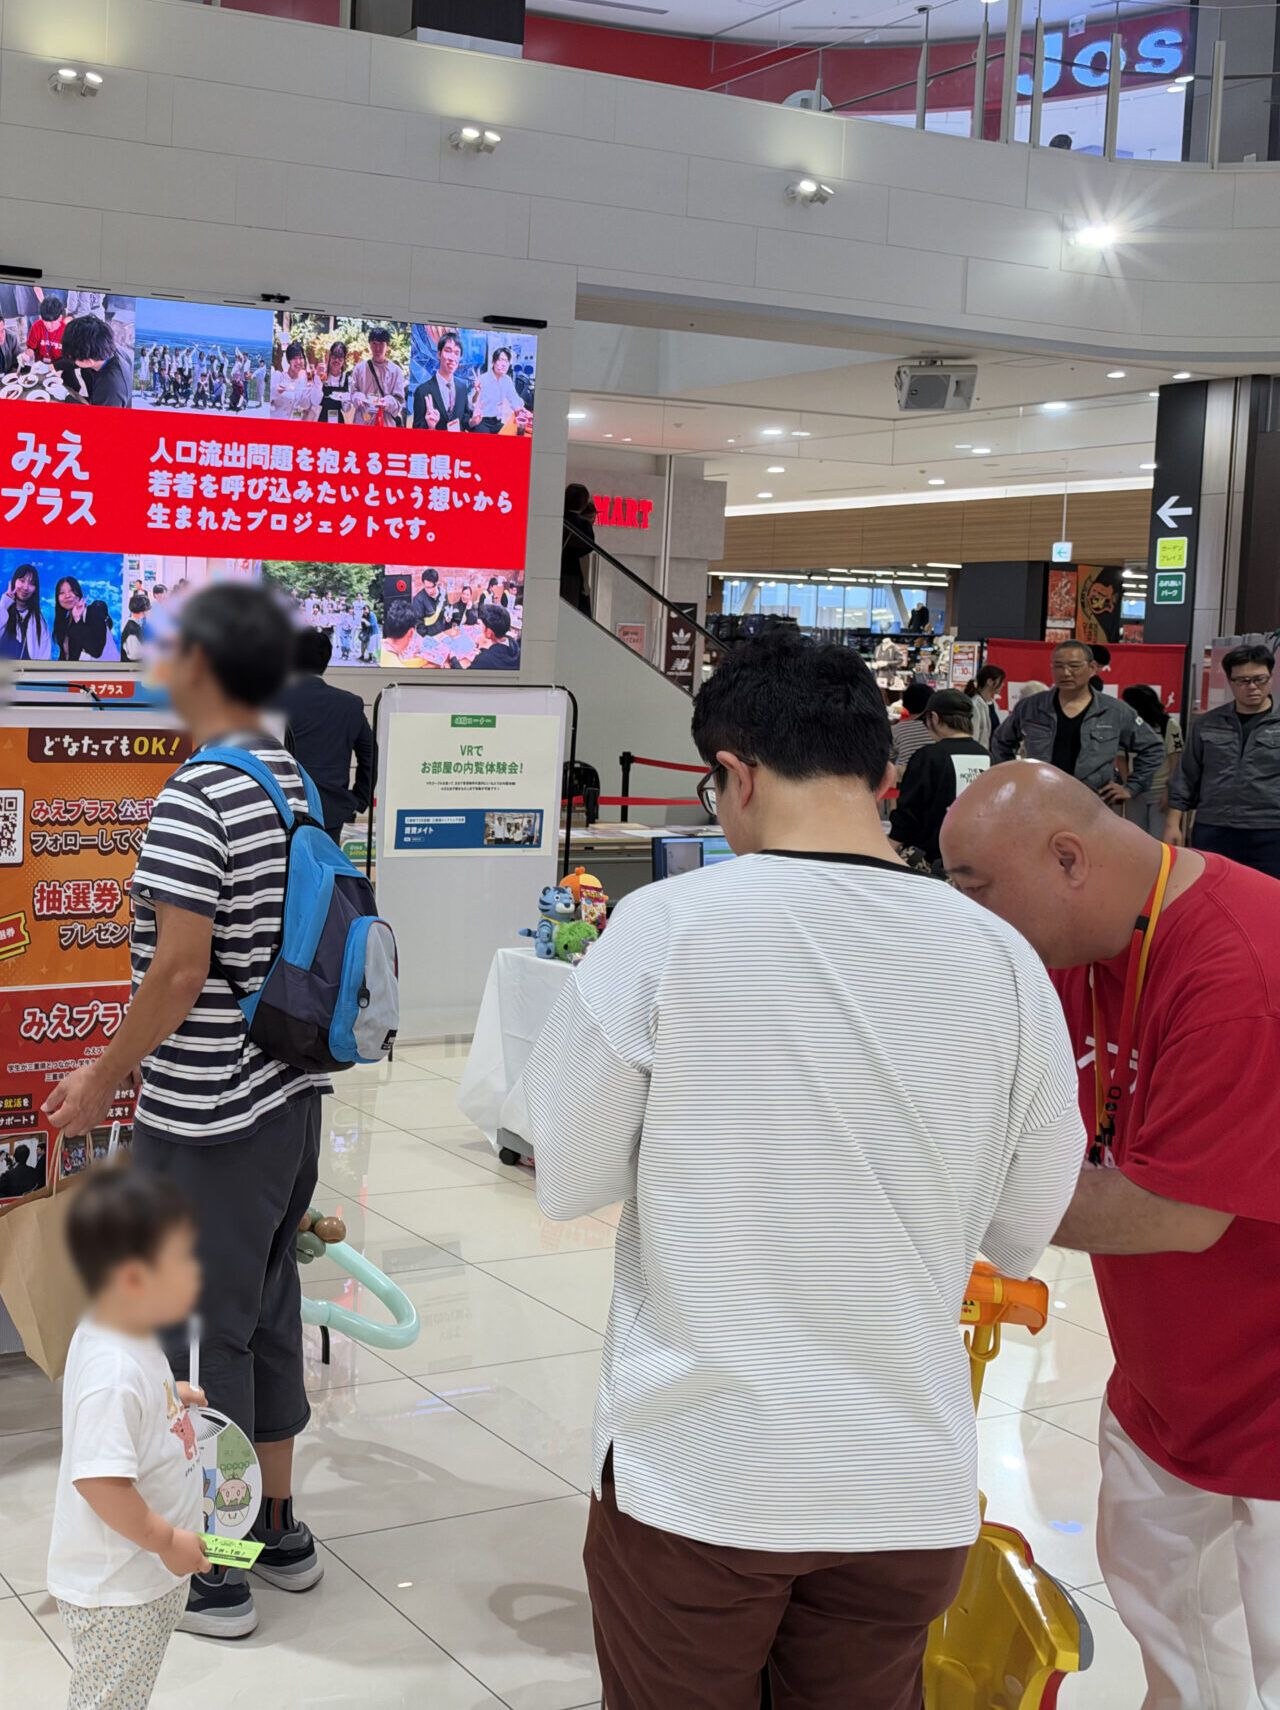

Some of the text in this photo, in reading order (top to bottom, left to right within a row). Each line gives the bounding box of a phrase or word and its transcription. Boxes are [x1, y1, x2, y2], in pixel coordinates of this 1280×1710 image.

[9, 429, 91, 481] みえ
[149, 437, 483, 482] 人口流出問題を抱える三重県に、
[0, 481, 97, 527] プラス
[147, 469, 514, 515] 若者を呼び込みたいという想いから
[146, 505, 437, 542] 生まれたプロジェクトです。
[43, 735, 181, 757] どなたでもOK!
[460, 745, 484, 757] VRで
[421, 761, 523, 775] お部屋の内覧体験会!
[33, 879, 134, 919] 抽選券
[20, 1000, 132, 1041] みえプラ
